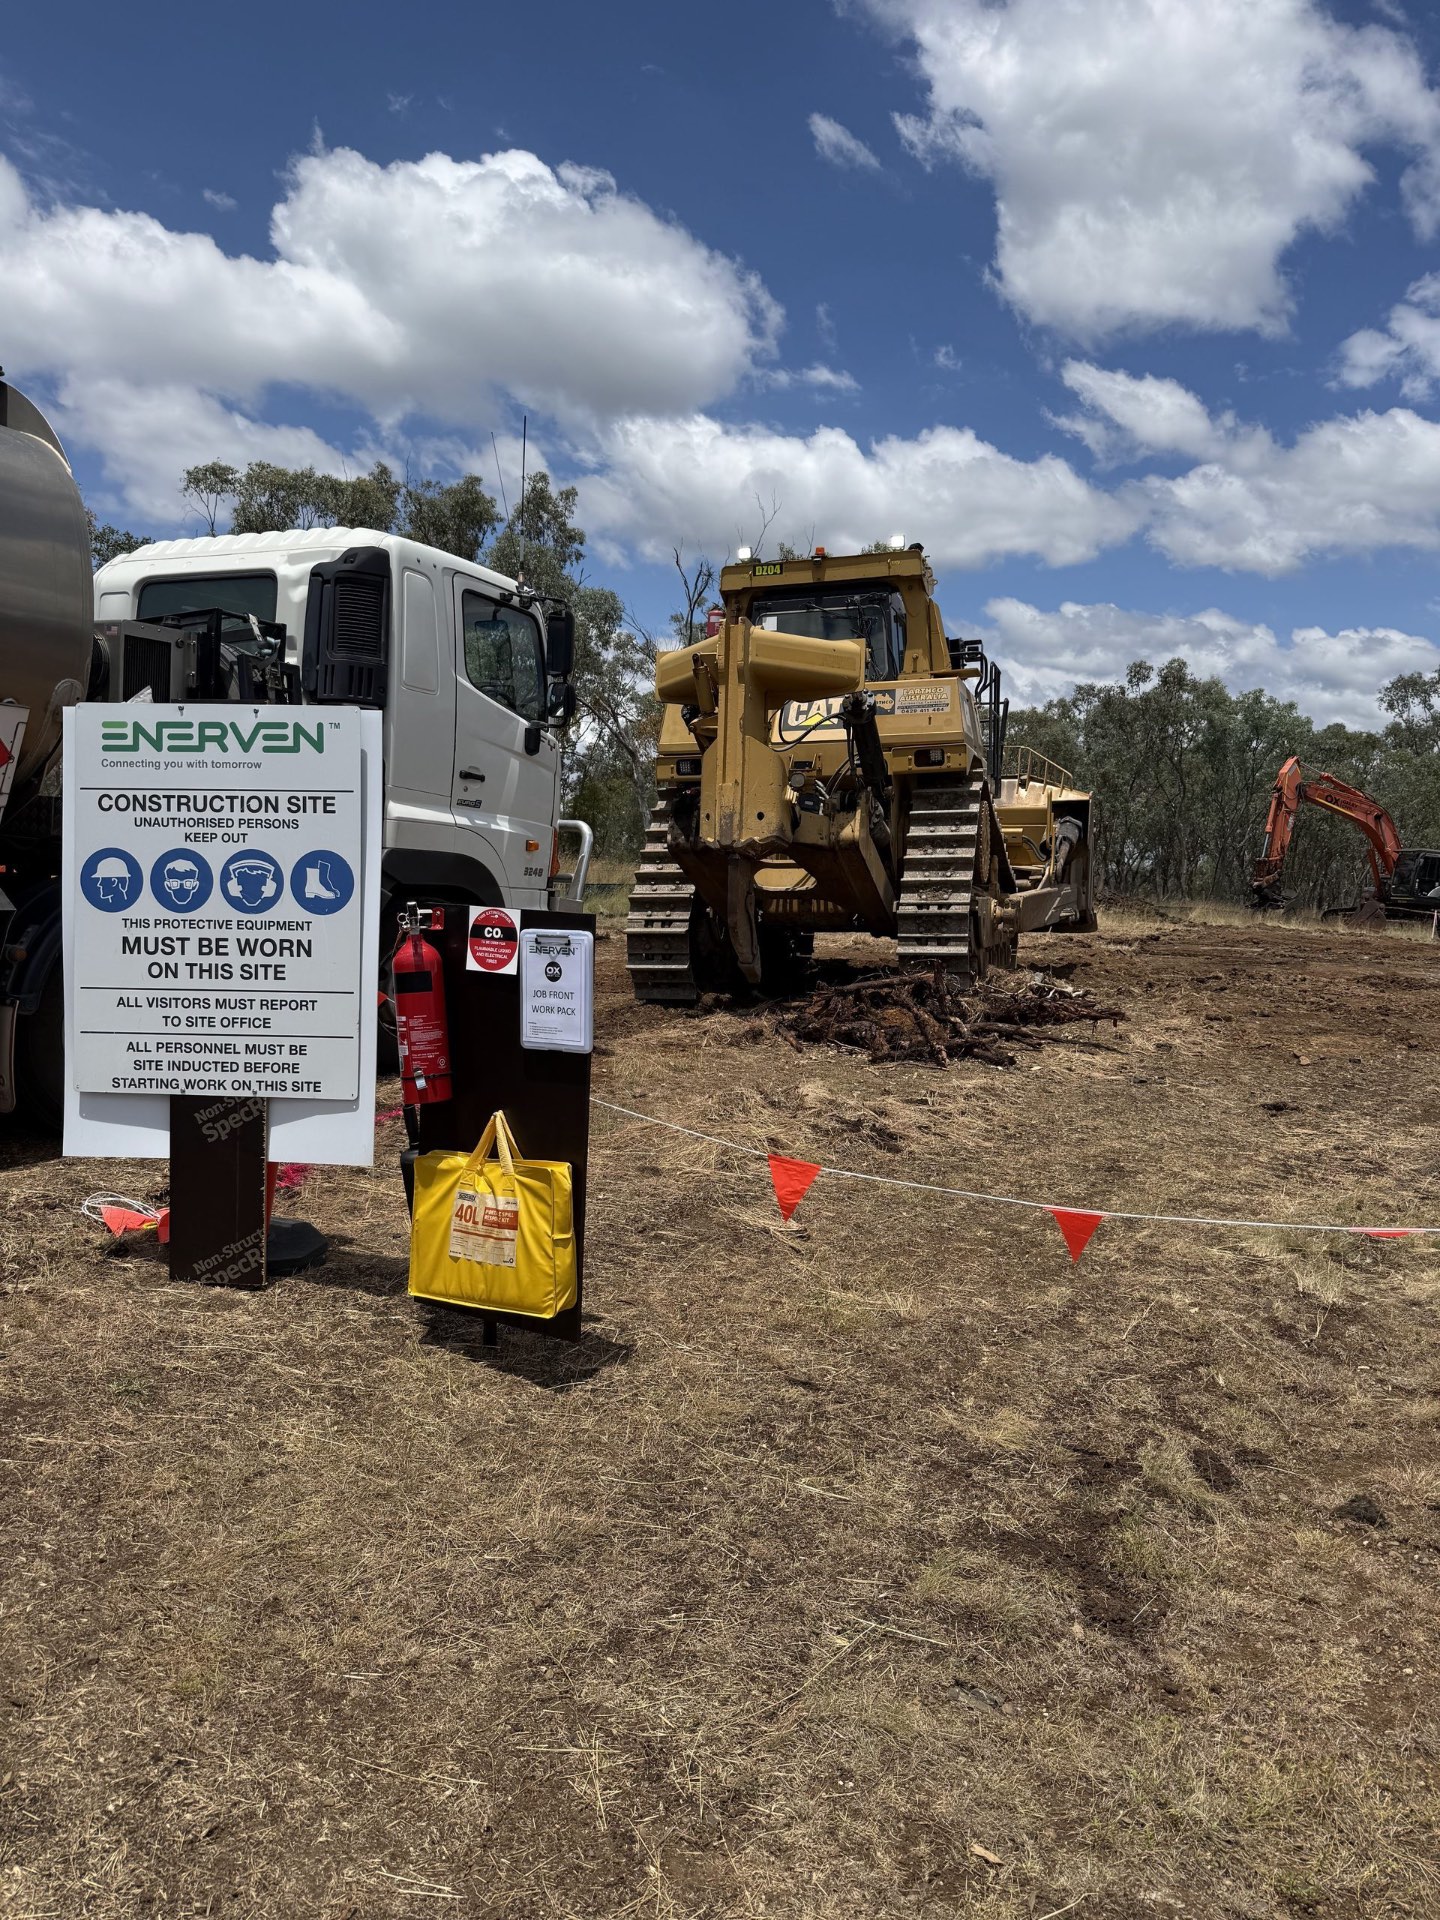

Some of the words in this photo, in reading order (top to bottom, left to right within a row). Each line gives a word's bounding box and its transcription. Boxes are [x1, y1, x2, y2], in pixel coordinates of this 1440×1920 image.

[755, 564, 781, 576] DZ04
[899, 693, 949, 702] AUSTRALIA
[787, 698, 843, 727] CAT
[101, 720, 325, 754] ENERVEN
[101, 758, 161, 771] Connecting
[163, 761, 183, 771] you
[186, 759, 208, 769] with
[211, 760, 262, 769] tomorrow
[97, 793, 280, 814] CONSTRUCTION
[286, 795, 336, 814] SITE
[134, 817, 235, 829] UNAUTHORISED
[238, 818, 299, 830] PERSONS
[184, 832, 218, 843] KEEP
[221, 832, 248, 843] OUT
[122, 918, 151, 929] THIS
[154, 918, 233, 930] PROTECTIVE
[236, 920, 313, 931] EQUIPMENT
[121, 935, 191, 956] MUST
[198, 937, 229, 957] BE
[235, 938, 313, 958] WORN
[528, 945, 575, 956] ENERVEN
[147, 961, 179, 979] ON
[185, 962, 234, 980] THIS
[239, 963, 287, 981] SITE
[546, 966, 561, 975] OX
[532, 989, 547, 999] JOB
[548, 990, 575, 1000] FRONT
[116, 996, 143, 1008] ALL
[146, 997, 211, 1009] VISITORS
[215, 998, 256, 1010] MUST
[259, 999, 318, 1011] REPORT
[531, 1004, 556, 1015] WORK
[556, 1006, 576, 1016] PACK
[162, 1015, 182, 1027] TO
[185, 1016, 216, 1028] SITE
[220, 1017, 272, 1029] OFFICE
[126, 1041, 152, 1053] ALL
[155, 1042, 241, 1055] PERSONNEL
[244, 1043, 285, 1056] MUST
[288, 1044, 308, 1056] BE
[133, 1059, 163, 1071] SITE
[167, 1060, 240, 1073] INDUCTED
[243, 1062, 300, 1074] BEFORE
[111, 1077, 180, 1090] STARTING
[183, 1078, 227, 1091] WORK
[231, 1080, 251, 1091] ON
[255, 1080, 288, 1092] THIS
[291, 1081, 322, 1093] SITE
[454, 1203, 480, 1226] 40L
